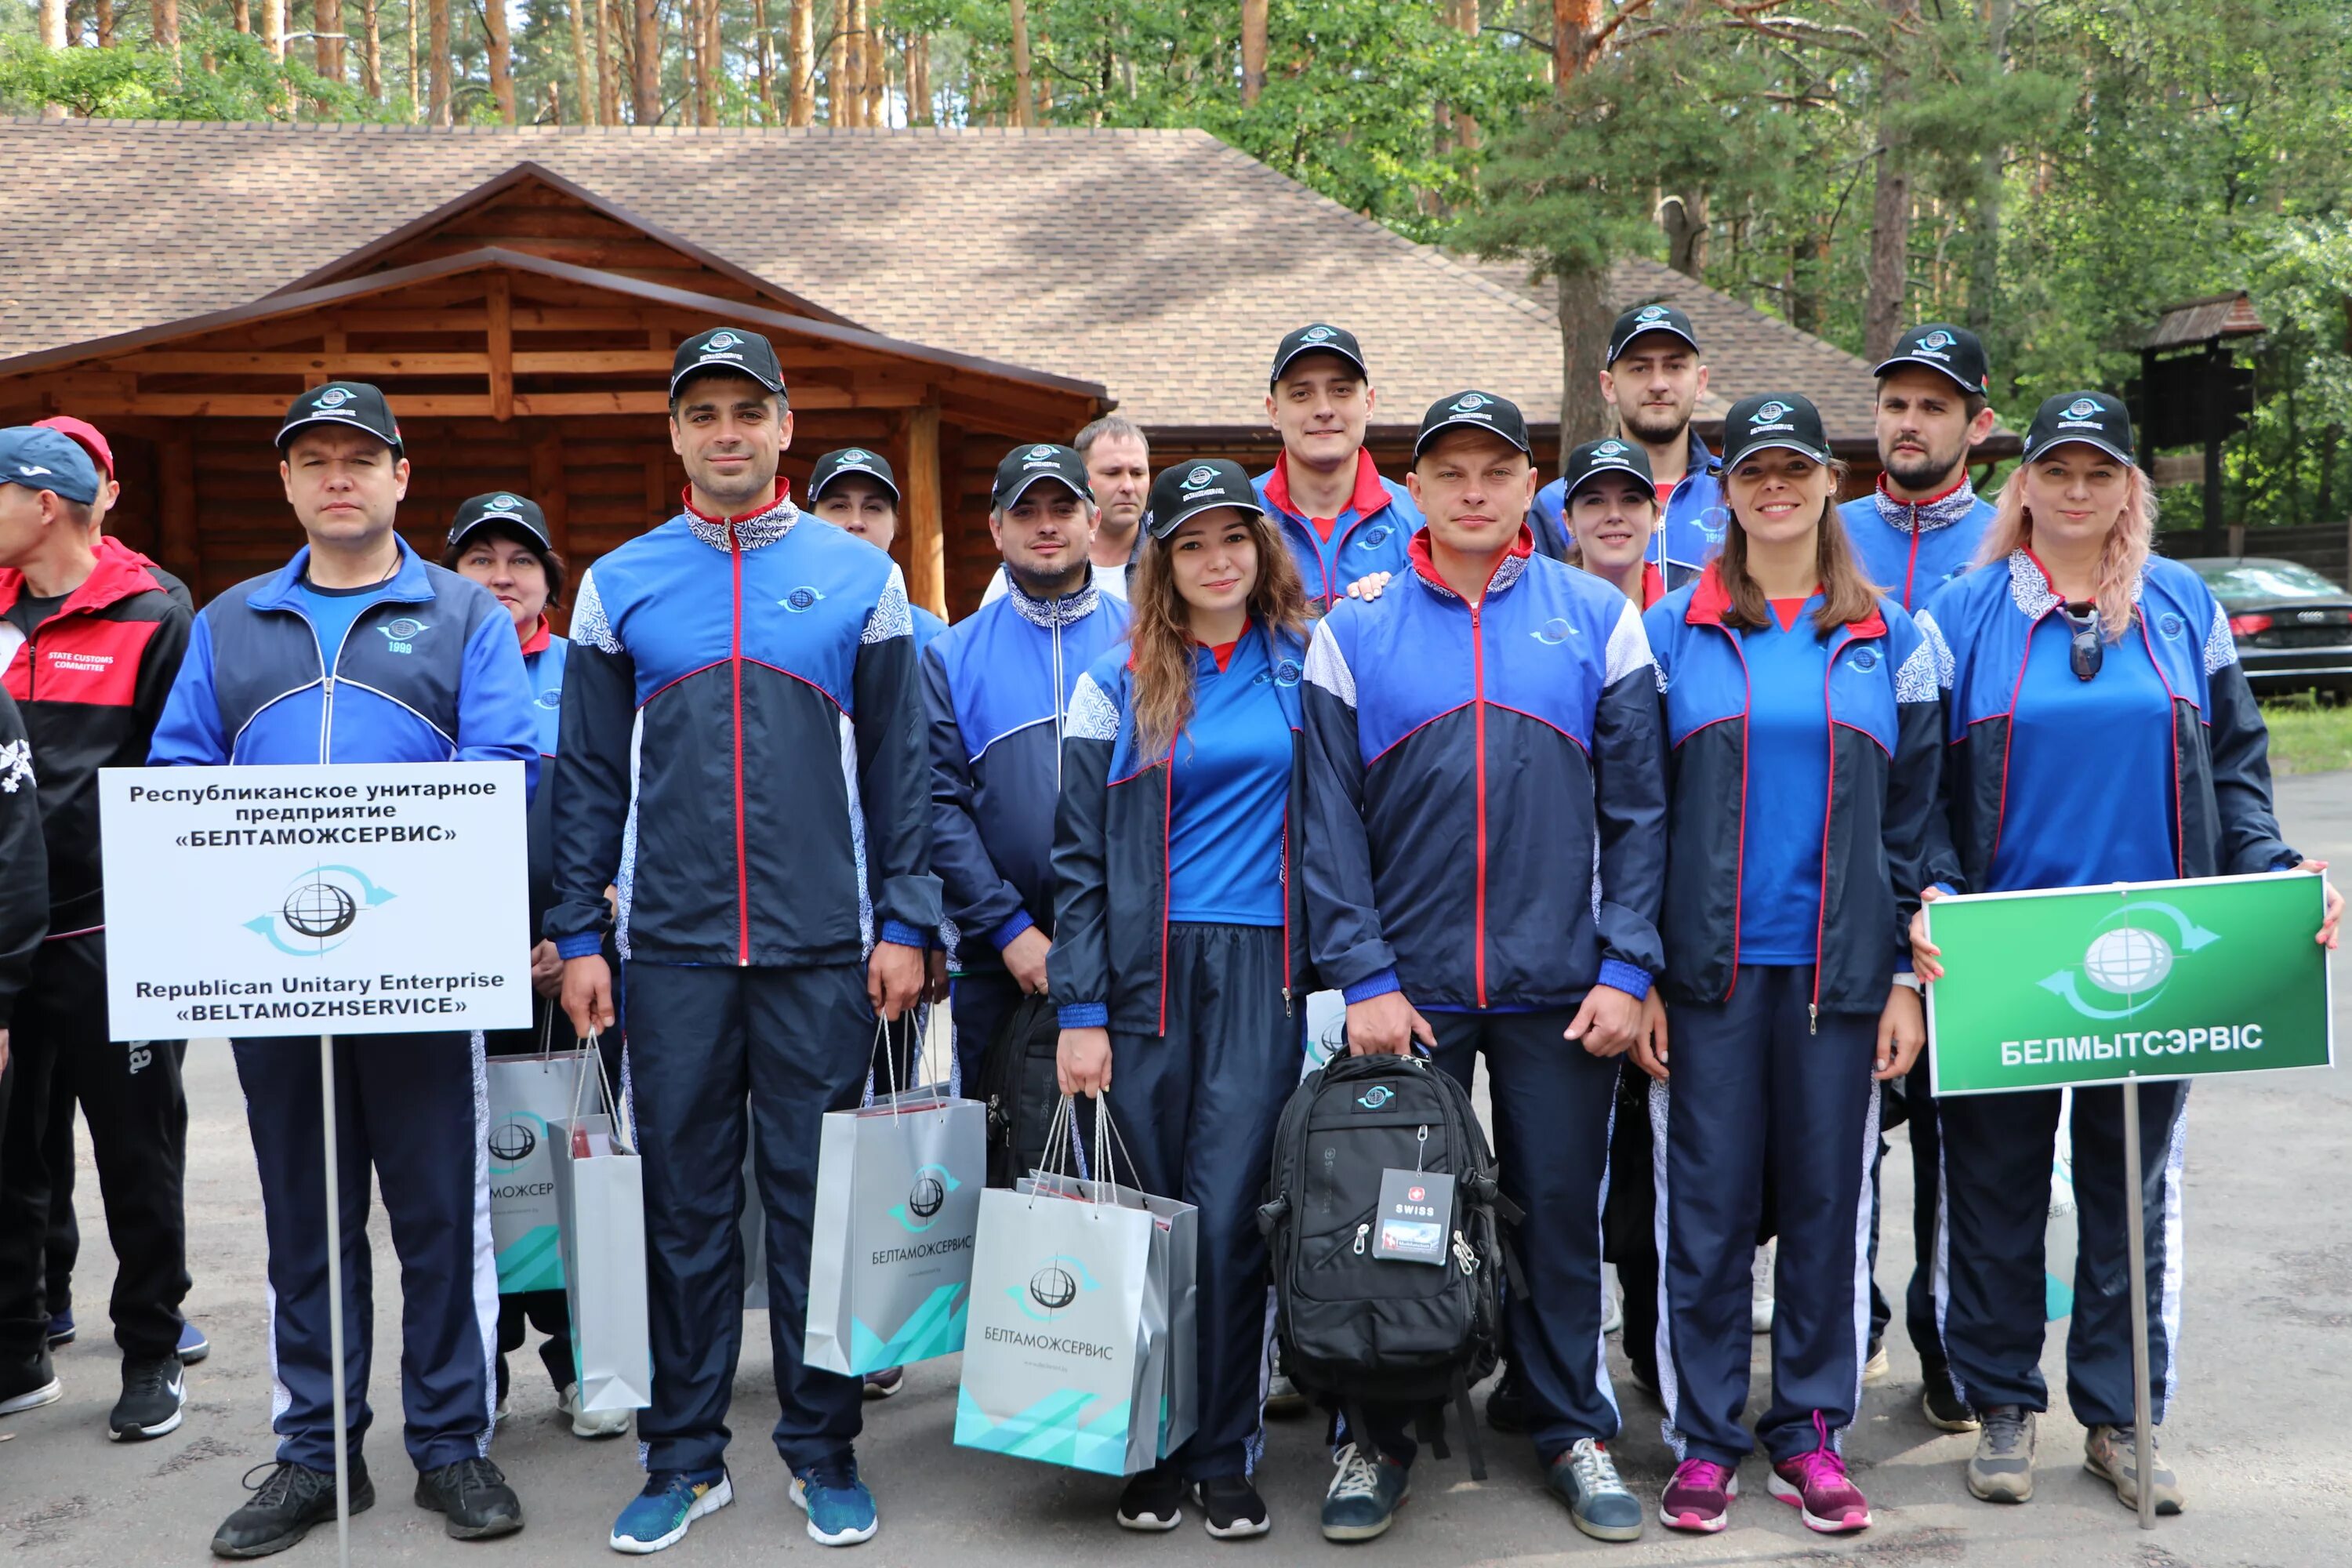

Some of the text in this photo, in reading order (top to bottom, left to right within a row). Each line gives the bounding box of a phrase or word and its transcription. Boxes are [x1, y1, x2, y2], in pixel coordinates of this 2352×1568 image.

[48, 652, 114, 664] STATE CUSTOMS
[389, 641, 412, 654] 1999
[54, 661, 105, 672] COMMITTEE
[129, 780, 497, 805] Республиканское унитарное
[235, 804, 397, 824] предприятие
[176, 825, 457, 848] «БЕЛТАМОЖСЕРВИС»
[136, 971, 505, 1000] Republican Unitary Enterprise
[176, 996, 468, 1022] «BELTAMOZHSERVICE»
[2001, 1022, 2264, 1067] БЕЛМЫТСЭРВІС
[1395, 1203, 1435, 1217] SWISS
[872, 1235, 972, 1265] БЕЛТАМОЖСЕРВИС
[984, 1326, 1114, 1361] БЕЛТАМОЖСЕРВИС
